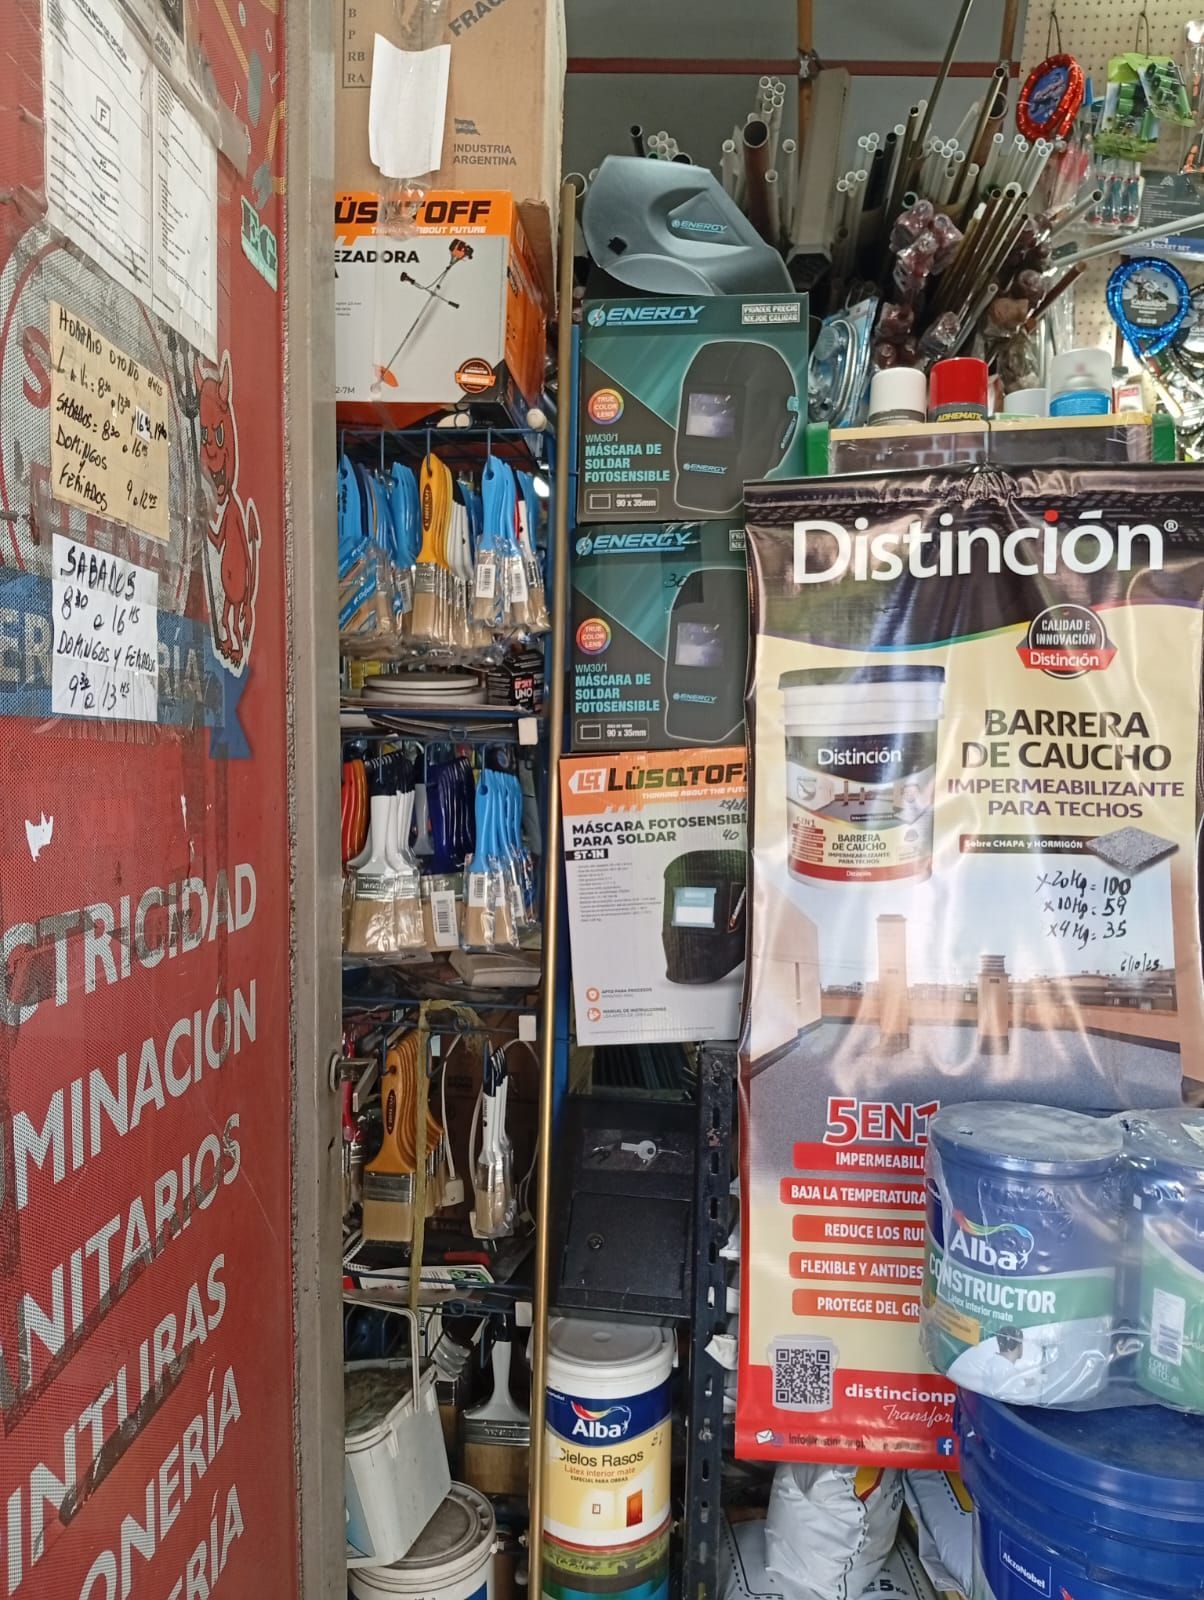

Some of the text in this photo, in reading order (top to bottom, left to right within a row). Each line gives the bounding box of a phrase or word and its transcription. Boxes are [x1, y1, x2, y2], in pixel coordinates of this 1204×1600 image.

[348, 8, 357, 18] B
[347, 30, 356, 40] P
[347, 51, 365, 61] RB
[347, 73, 365, 83] RA
[453, 143, 512, 154] INDUSTRIA
[453, 155, 517, 166] ARGENTINA
[680, 220, 728, 232] ENERGY
[335, 250, 420, 264] EZADORA
[606, 305, 706, 321] ENERGY
[56, 346, 65, 373] L
[585, 433, 619, 443] WM30/1
[585, 443, 662, 457] MÁSCARA DE
[585, 457, 631, 470] SOLDAR
[690, 463, 728, 474] ENERGY
[585, 470, 671, 483] FOTOSENSIBLE
[593, 532, 692, 549] ENERGY
[1041, 619, 1091, 631] CALIDAD E
[1035, 630, 1097, 646] INNOVACIÓN
[56, 630, 110, 663] DOMINGOS
[1029, 651, 1100, 667] Distinción
[575, 663, 608, 673] WM30/1
[575, 673, 651, 687] MÁSCARA DE
[515, 687, 533, 700] UNO
[575, 687, 620, 700] SOLDAR
[680, 693, 718, 704] ENERGY
[575, 700, 660, 713] FOTOSENSIBLE
[984, 709, 1151, 739] BARRERA
[606, 728, 616, 737] 90
[624, 728, 647, 737] 35mm
[817, 747, 903, 766] Distinción
[961, 741, 1173, 772] DE CAUCHO
[947, 778, 1185, 798] IMPERMEABILIZANTE
[988, 800, 1144, 818] PARA TECHOS
[572, 820, 645, 835] MÁSCARA
[722, 828, 740, 841] 40
[573, 831, 677, 848] PARA SOLDAR
[837, 833, 881, 842] BARRERA
[992, 839, 1025, 850] CHAPA
[1026, 841, 1032, 850] y
[1033, 839, 1084, 850] HORMIGÓN
[832, 842, 887, 851] DE CAUCHO
[1102, 895, 1128, 917] 59
[1102, 919, 1127, 939] 35
[791, 1184, 926, 1205] BAJA LA TEMPERATURA
[824, 1223, 874, 1239] REDUCE
[876, 1225, 900, 1240] LOS
[950, 1225, 1018, 1271] Alba
[0, 1112, 241, 1411] NITARIOS
[800, 1259, 856, 1276] FLEXIBLE
[858, 1262, 867, 1276] Y
[816, 1296, 872, 1314] PROTEGE
[875, 1300, 899, 1316] DEL
[845, 1382, 956, 1406] distincionp
[882, 1403, 954, 1429] Transfor
[572, 1418, 622, 1439] Alba
[602, 1450, 644, 1468] Rasos
[564, 1464, 636, 1478] Látex interior mate
[1002, 1551, 1046, 1590] AkzoNobel
